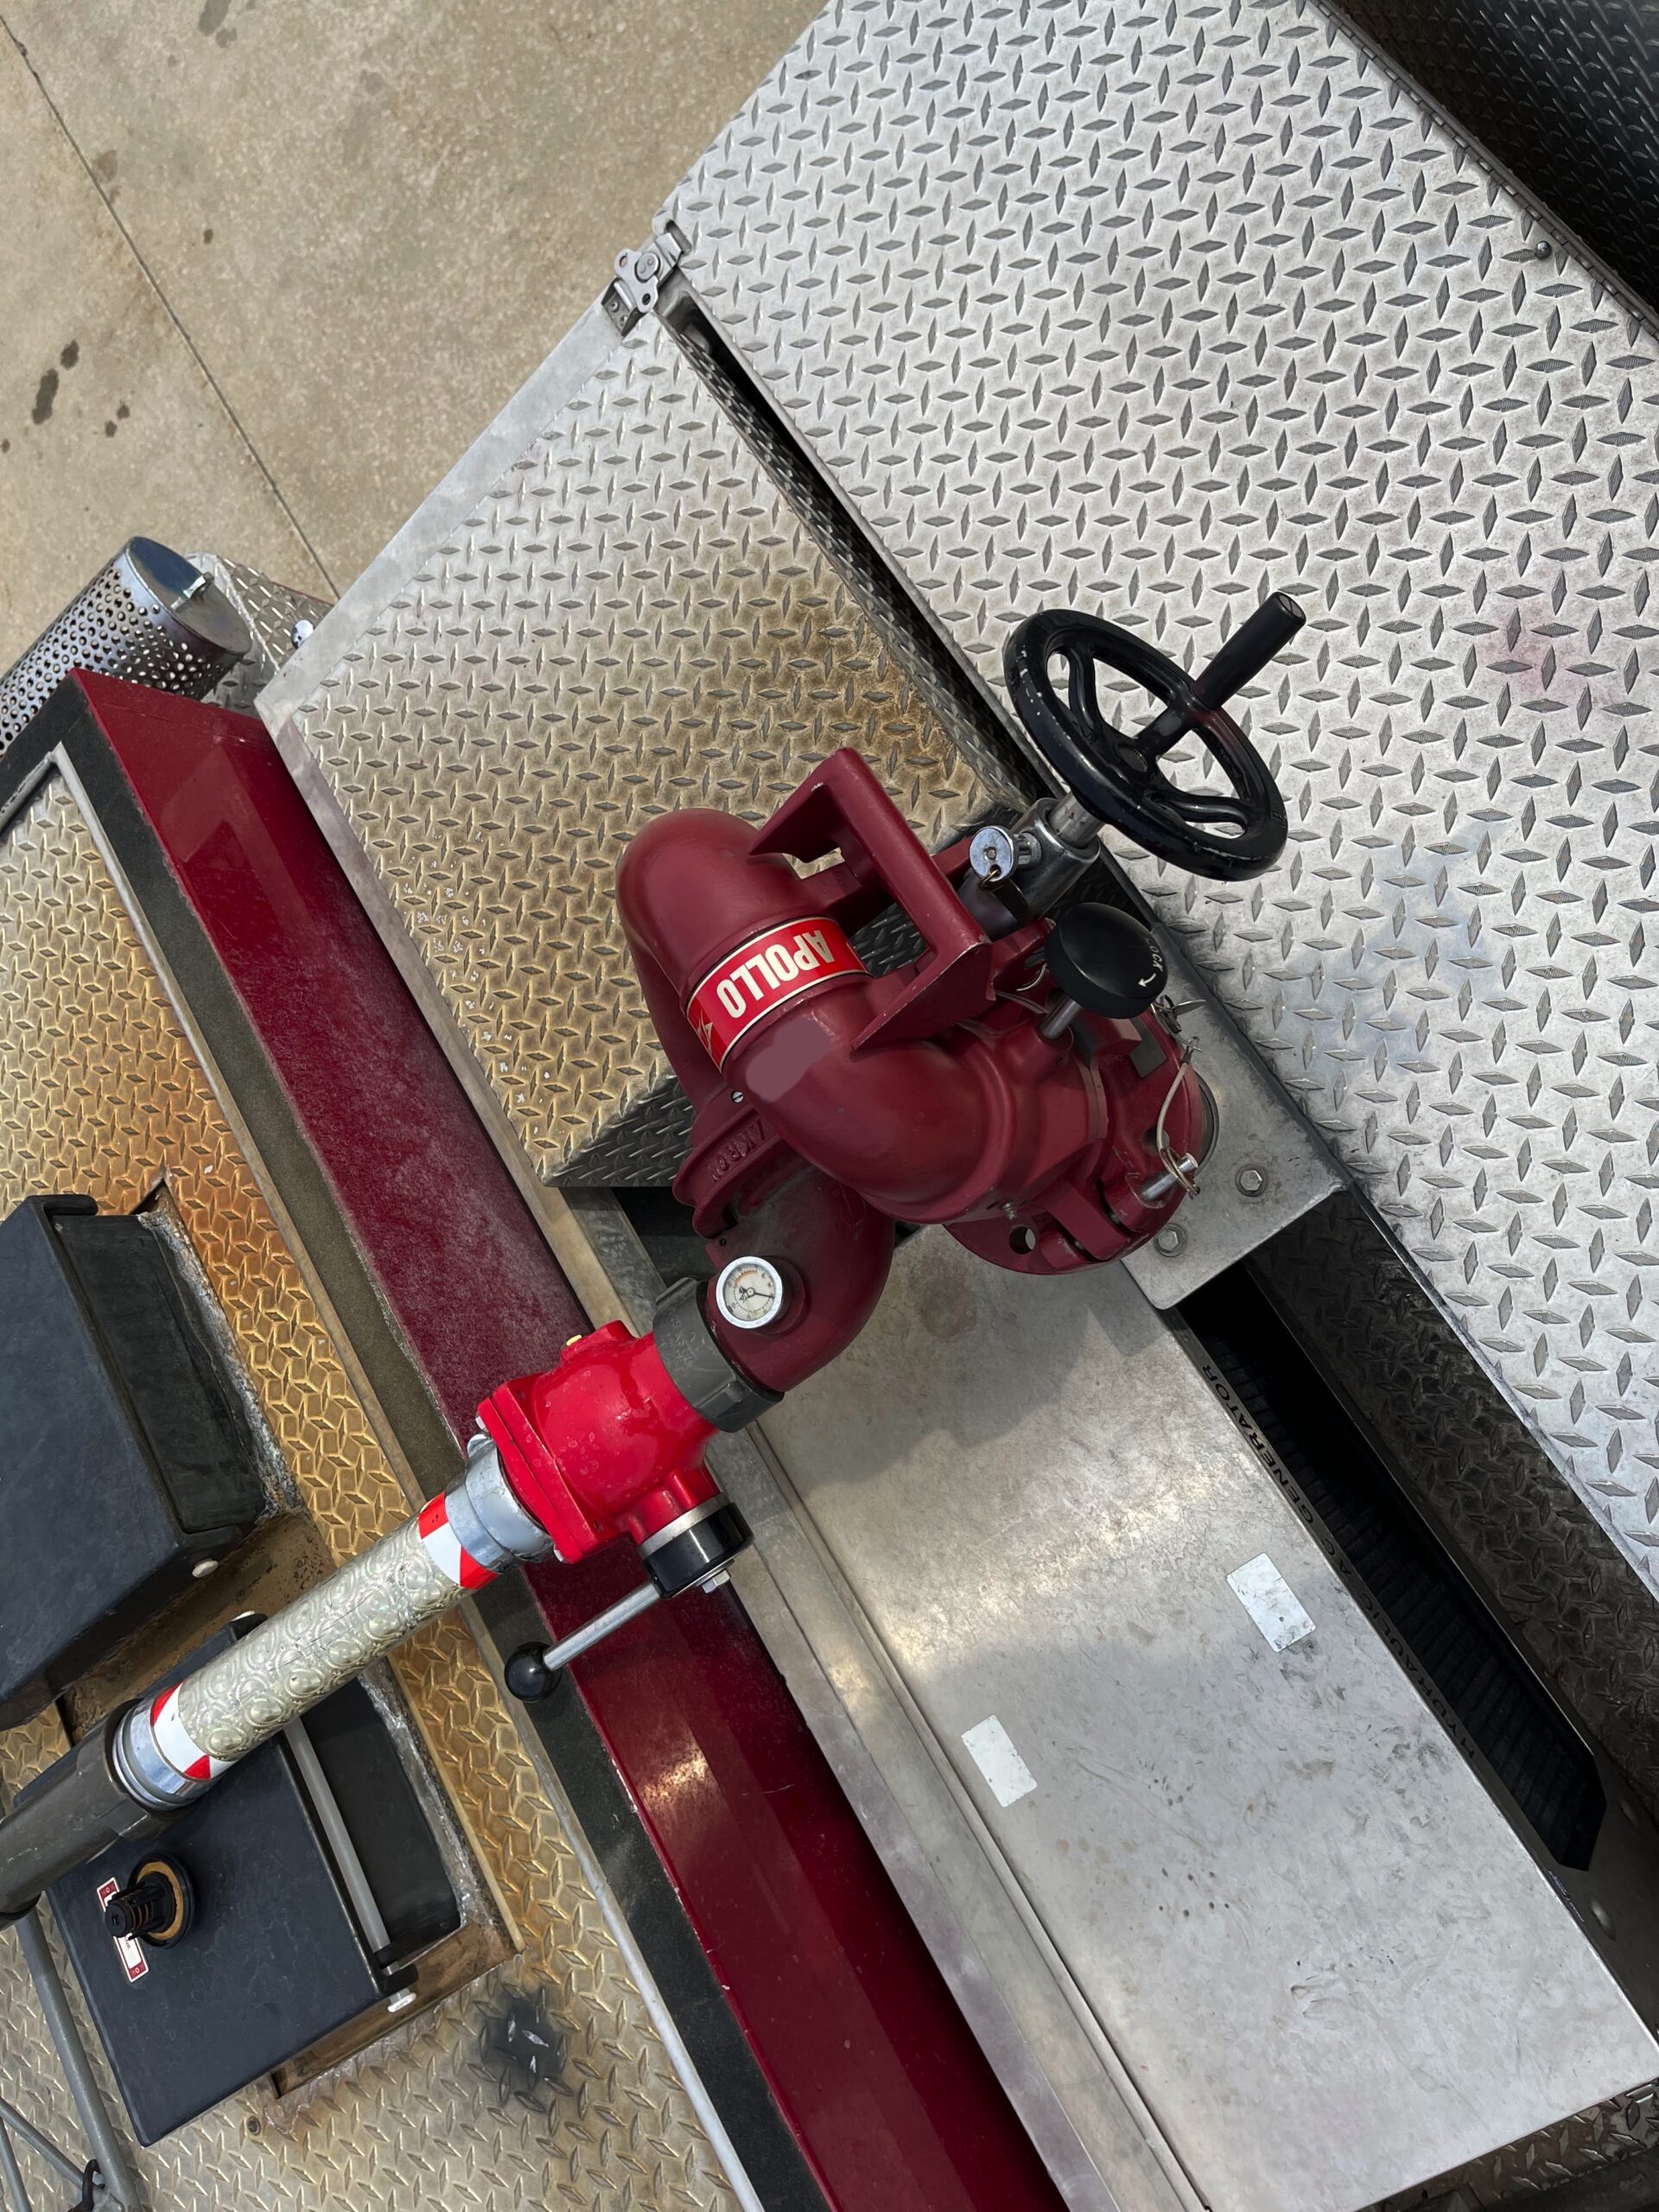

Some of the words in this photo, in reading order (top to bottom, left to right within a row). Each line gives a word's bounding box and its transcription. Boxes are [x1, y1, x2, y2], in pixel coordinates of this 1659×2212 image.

[716, 930, 836, 1019] APOLLO
[1144, 938, 1164, 972] LOCK
[1202, 1364, 1314, 1524] GENERATOR
[1321, 1537, 1352, 1576] AC
[1361, 1592, 1475, 1758] HYDRAULIC
